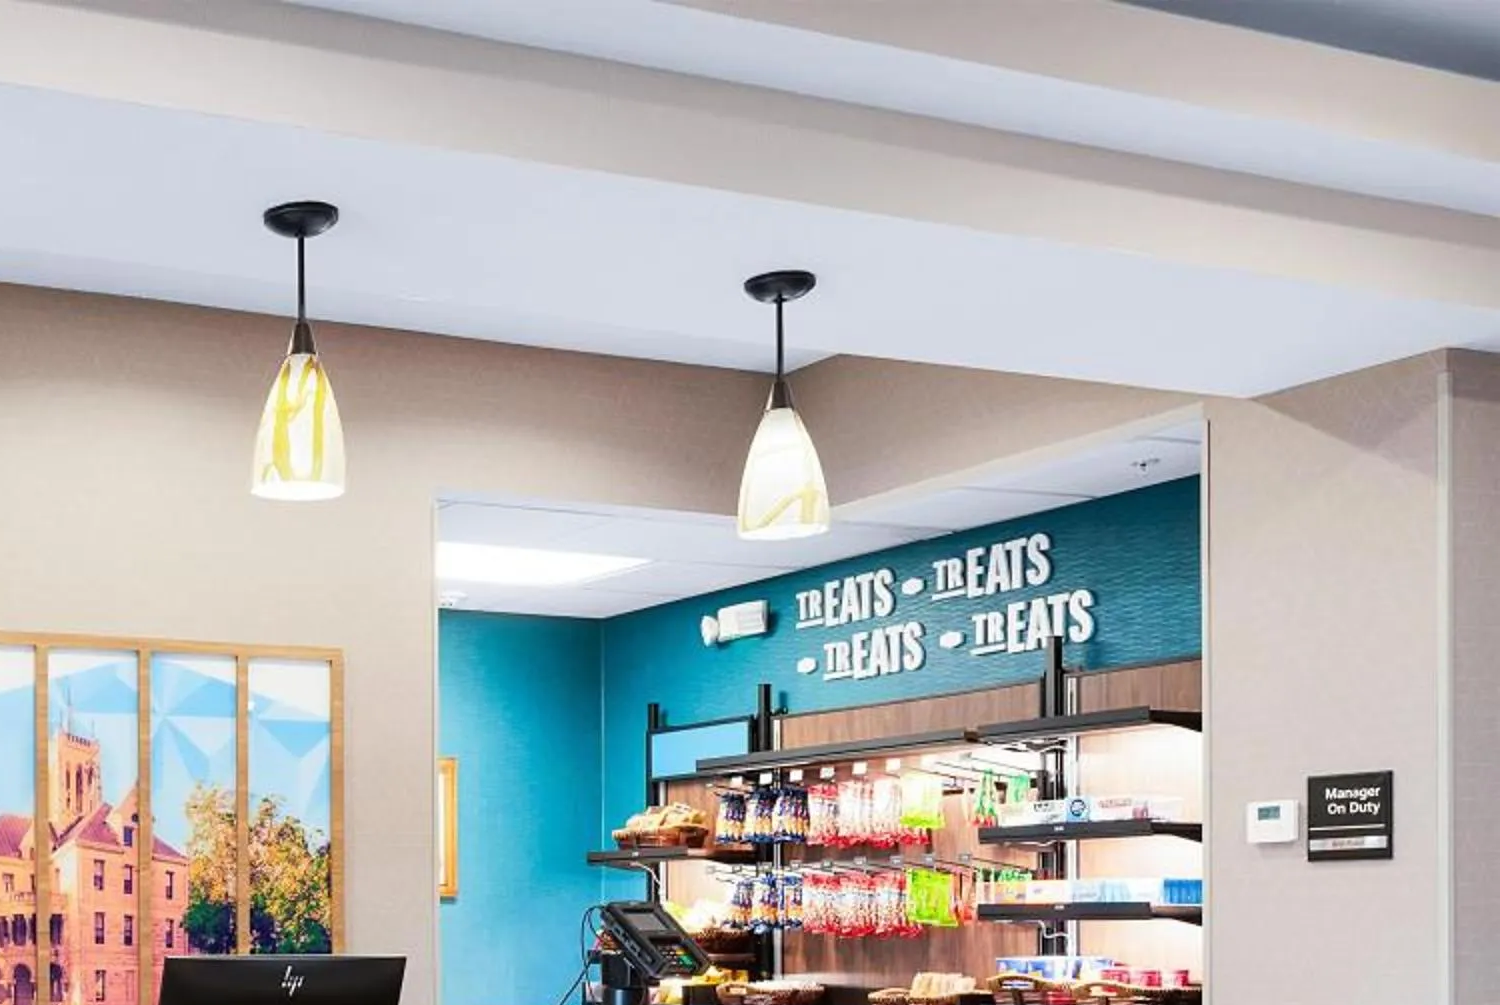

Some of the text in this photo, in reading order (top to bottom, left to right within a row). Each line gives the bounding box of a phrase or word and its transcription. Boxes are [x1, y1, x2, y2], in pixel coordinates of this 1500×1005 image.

[796, 533, 1051, 627] TREATS TREATS
[824, 589, 1095, 680] TREATS TREATS
[1325, 787, 1381, 801] Manager
[1327, 802, 1381, 815] On Duty
